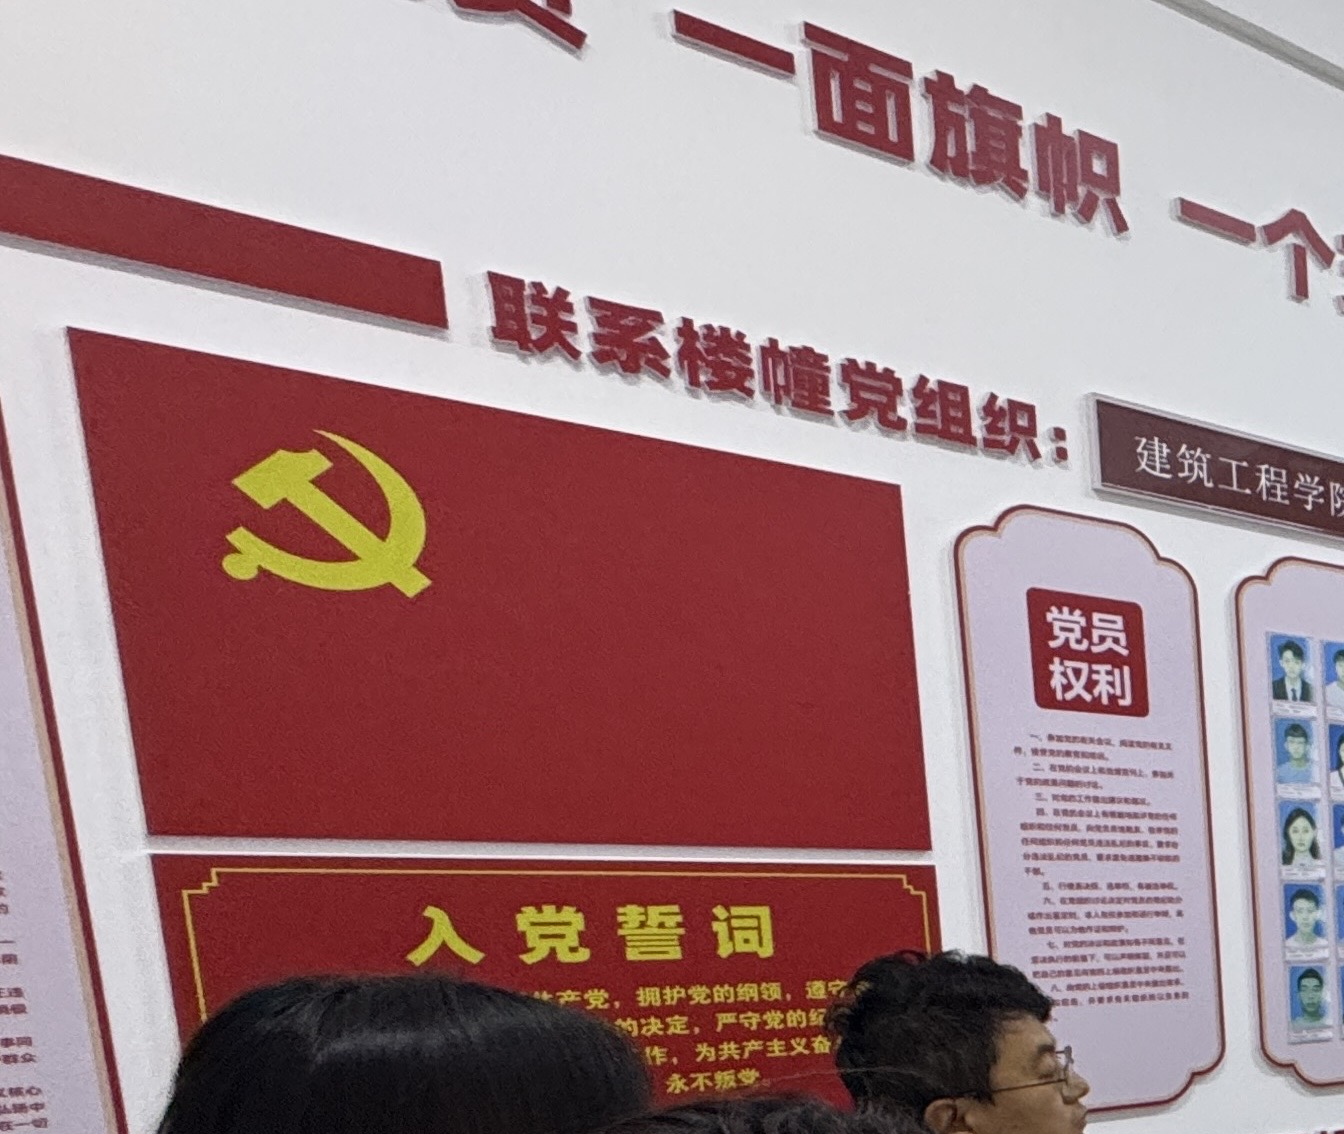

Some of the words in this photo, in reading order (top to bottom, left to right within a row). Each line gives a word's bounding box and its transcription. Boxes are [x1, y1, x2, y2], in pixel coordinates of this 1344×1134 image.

[672, 10, 1128, 235] 一面旗帜
[1045, 605, 1130, 656] 党员
[1048, 656, 1133, 707] 权利
[407, 904, 776, 966] 入党誓词
